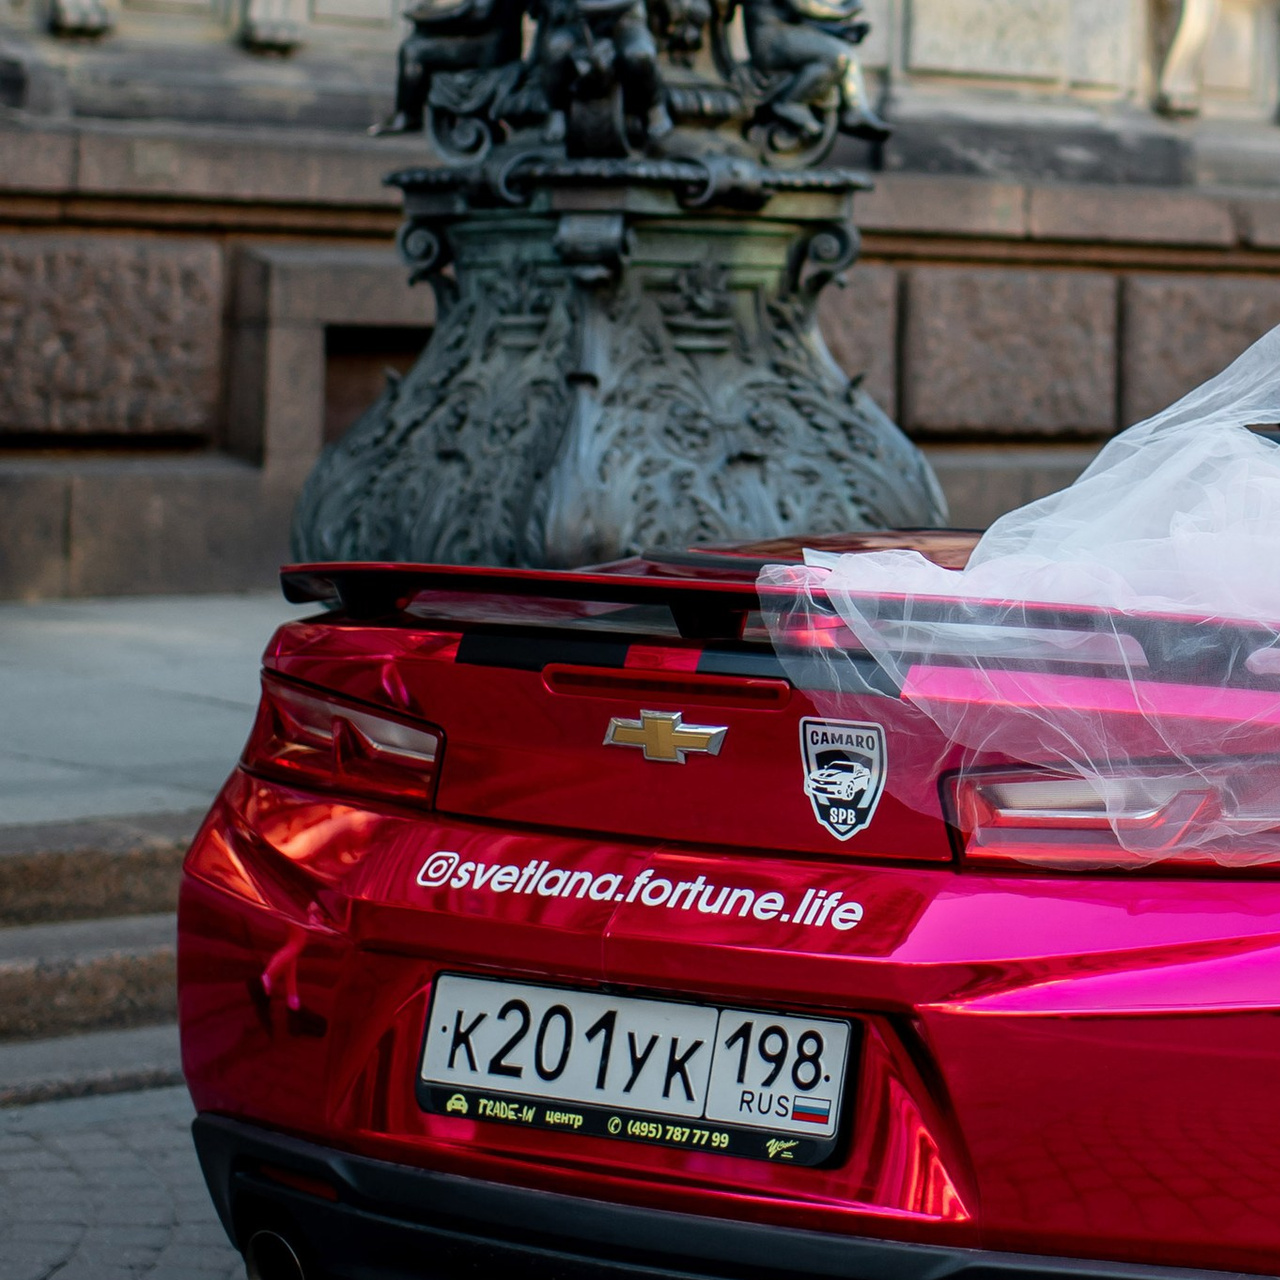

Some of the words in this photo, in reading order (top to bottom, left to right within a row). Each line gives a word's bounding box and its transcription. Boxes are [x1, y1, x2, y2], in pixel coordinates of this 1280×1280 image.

[810, 730, 875, 751] CAMARO
[829, 807, 856, 825] SPB
[450, 860, 864, 930] svetlana.fortune.life
[447, 999, 704, 1102] К201УК
[724, 1021, 824, 1091] 198
[478, 1098, 537, 1122] TRADE-IN
[545, 1110, 583, 1129] центр
[739, 1090, 790, 1117] RUS
[627, 1120, 662, 1139] (495)
[665, 1125, 690, 1142] 787
[692, 1129, 710, 1145] 77
[711, 1132, 729, 1148] 99
